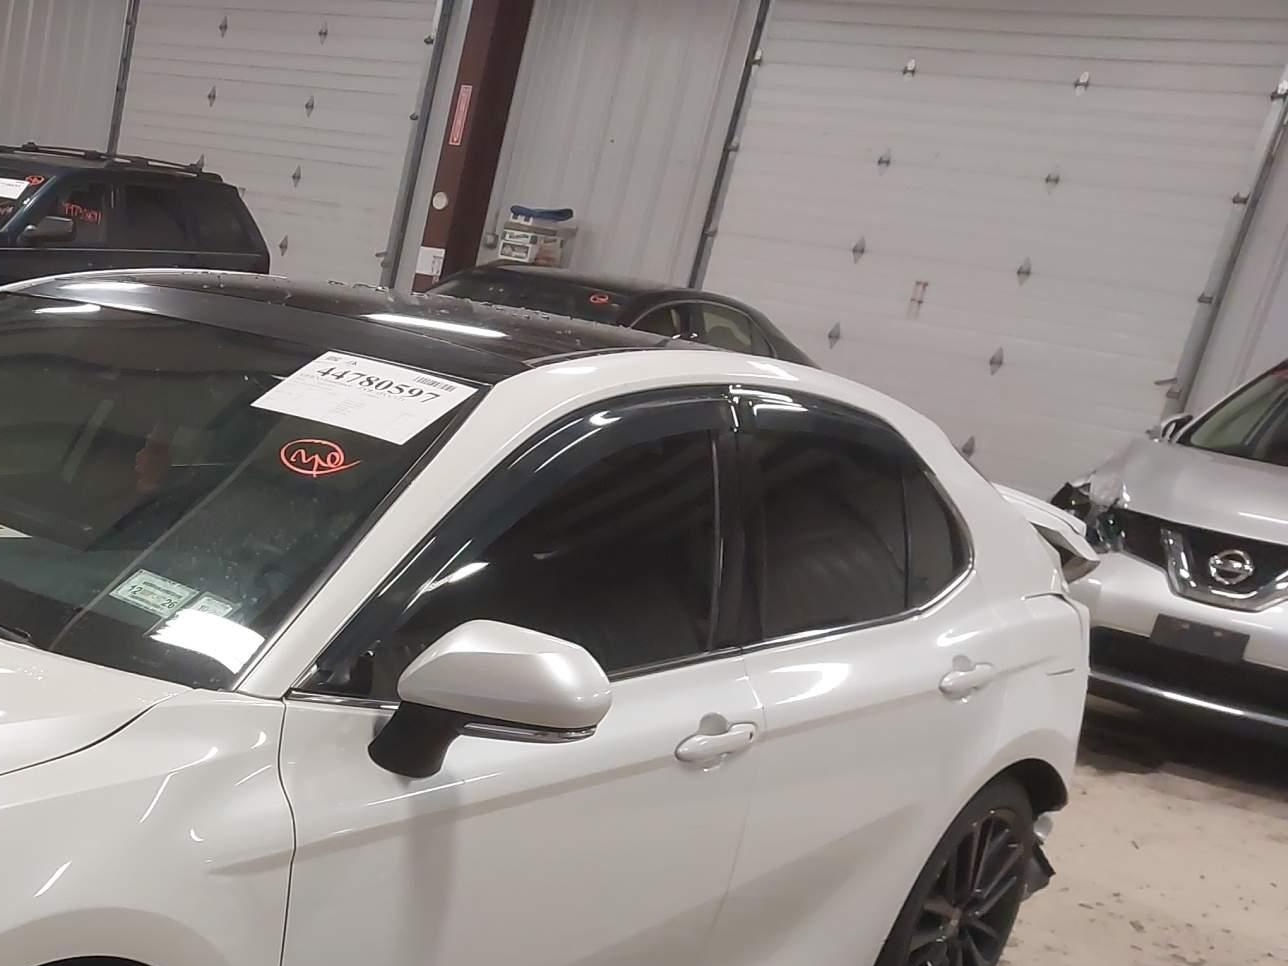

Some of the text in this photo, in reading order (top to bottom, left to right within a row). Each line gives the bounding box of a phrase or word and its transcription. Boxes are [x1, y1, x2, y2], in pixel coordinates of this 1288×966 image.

[316, 366, 440, 404] 44780597
[128, 585, 142, 595] 12
[161, 598, 179, 609] 26
